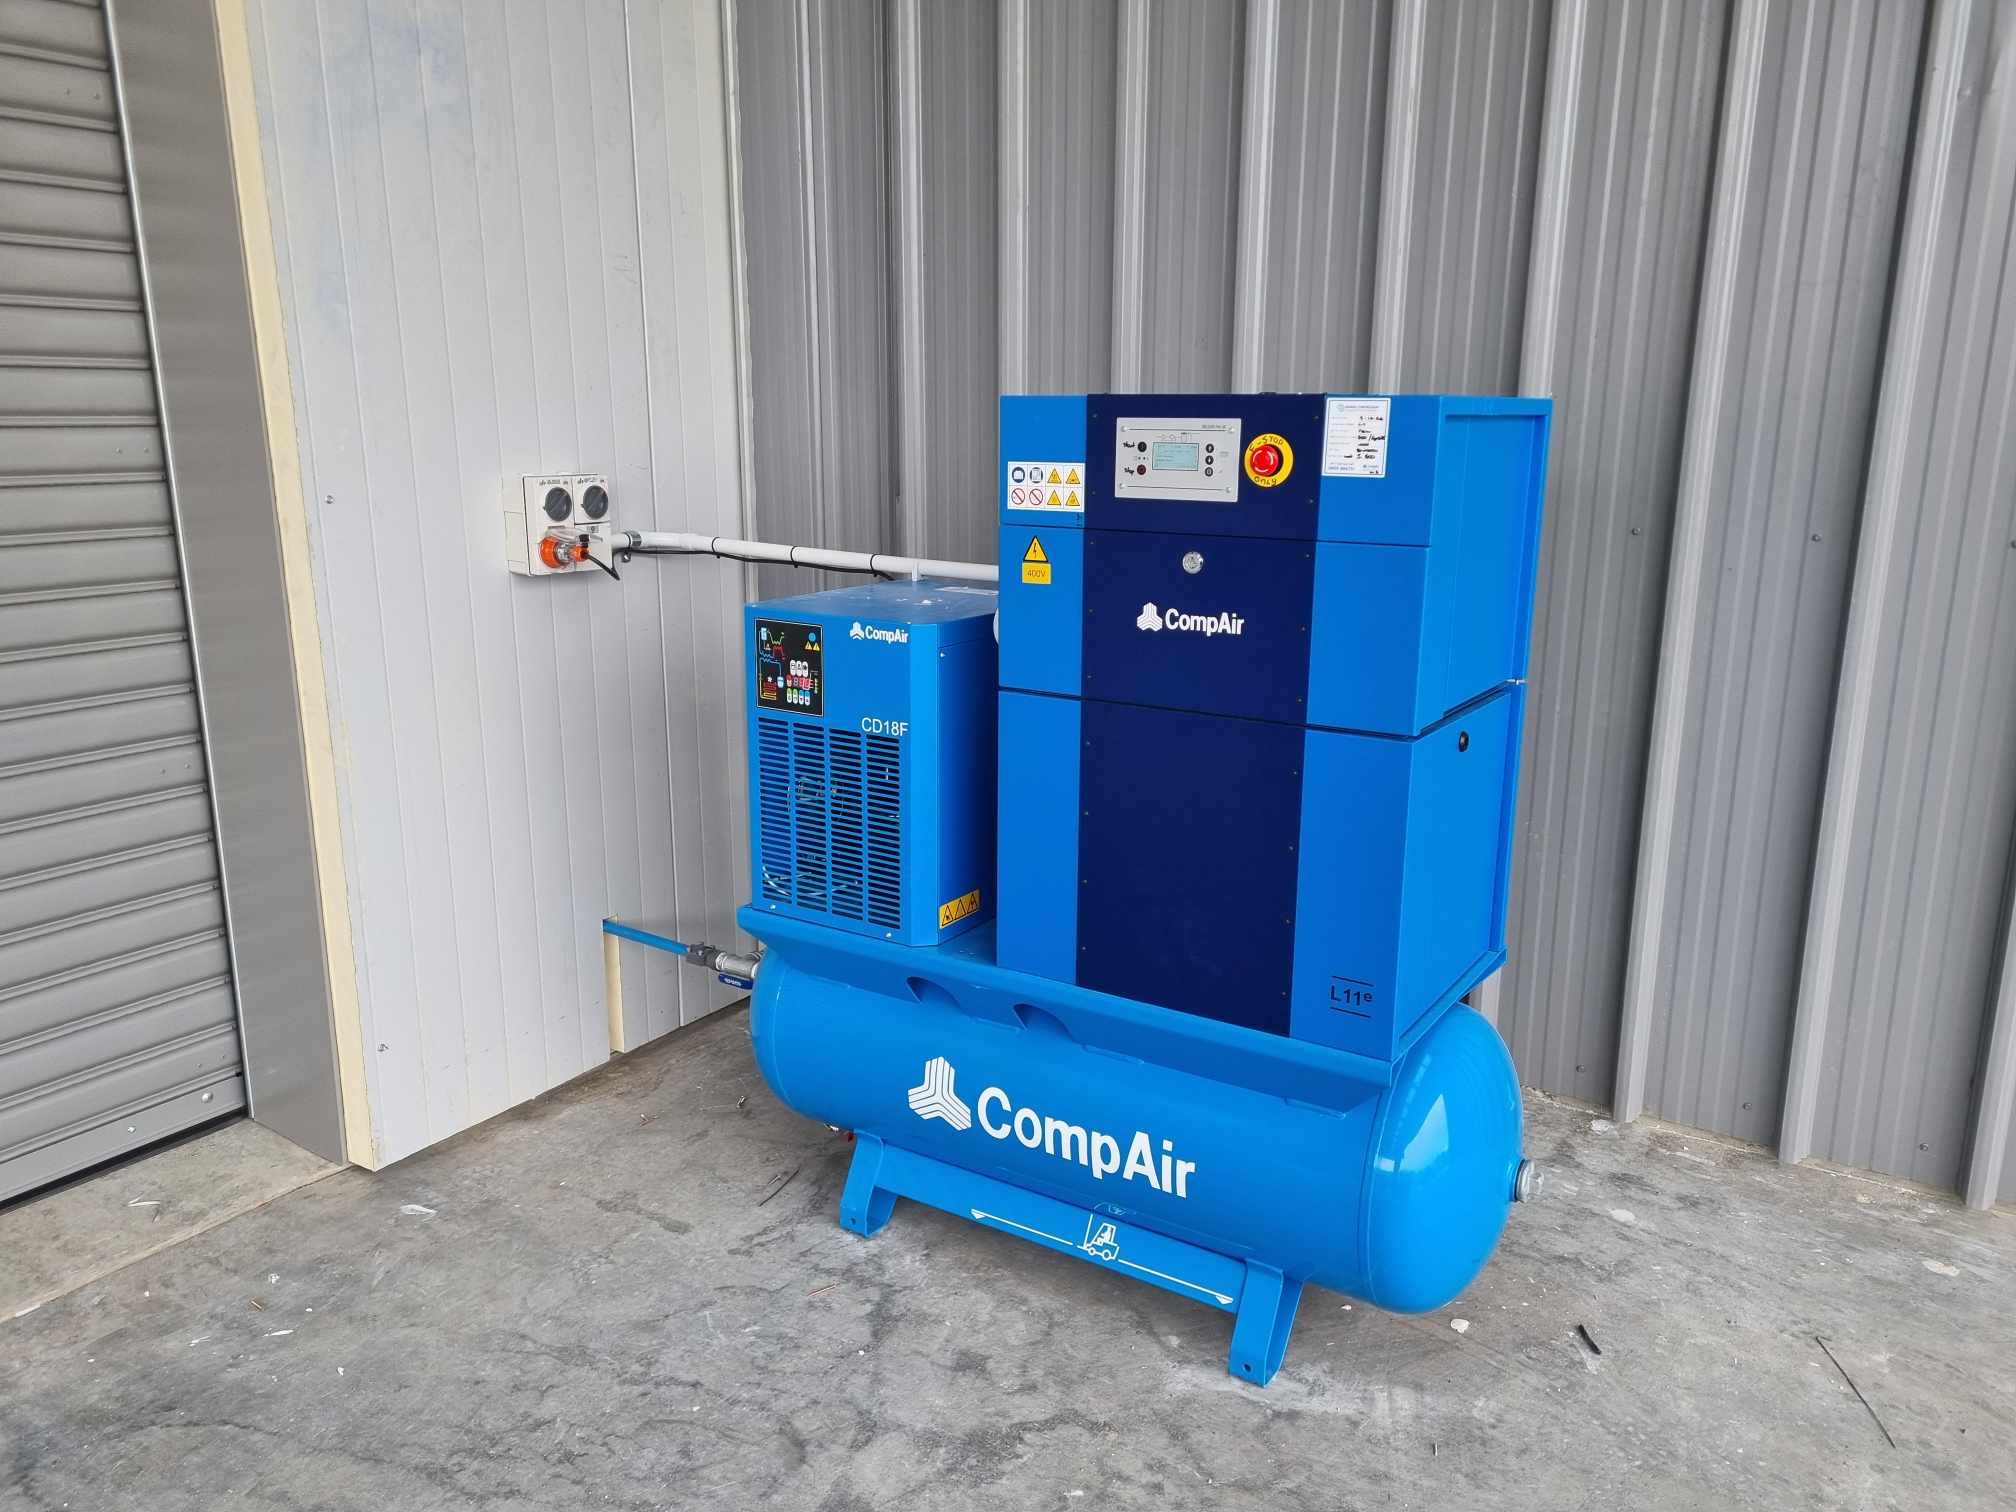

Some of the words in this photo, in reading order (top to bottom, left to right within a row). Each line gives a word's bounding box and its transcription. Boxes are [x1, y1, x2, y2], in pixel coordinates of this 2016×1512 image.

[1027, 568, 1046, 578] 400V
[1165, 608, 1245, 637] CompAir
[865, 625, 909, 644] CompAir
[861, 717, 909, 737] CD18F
[977, 1086, 1196, 1198] CompAir
